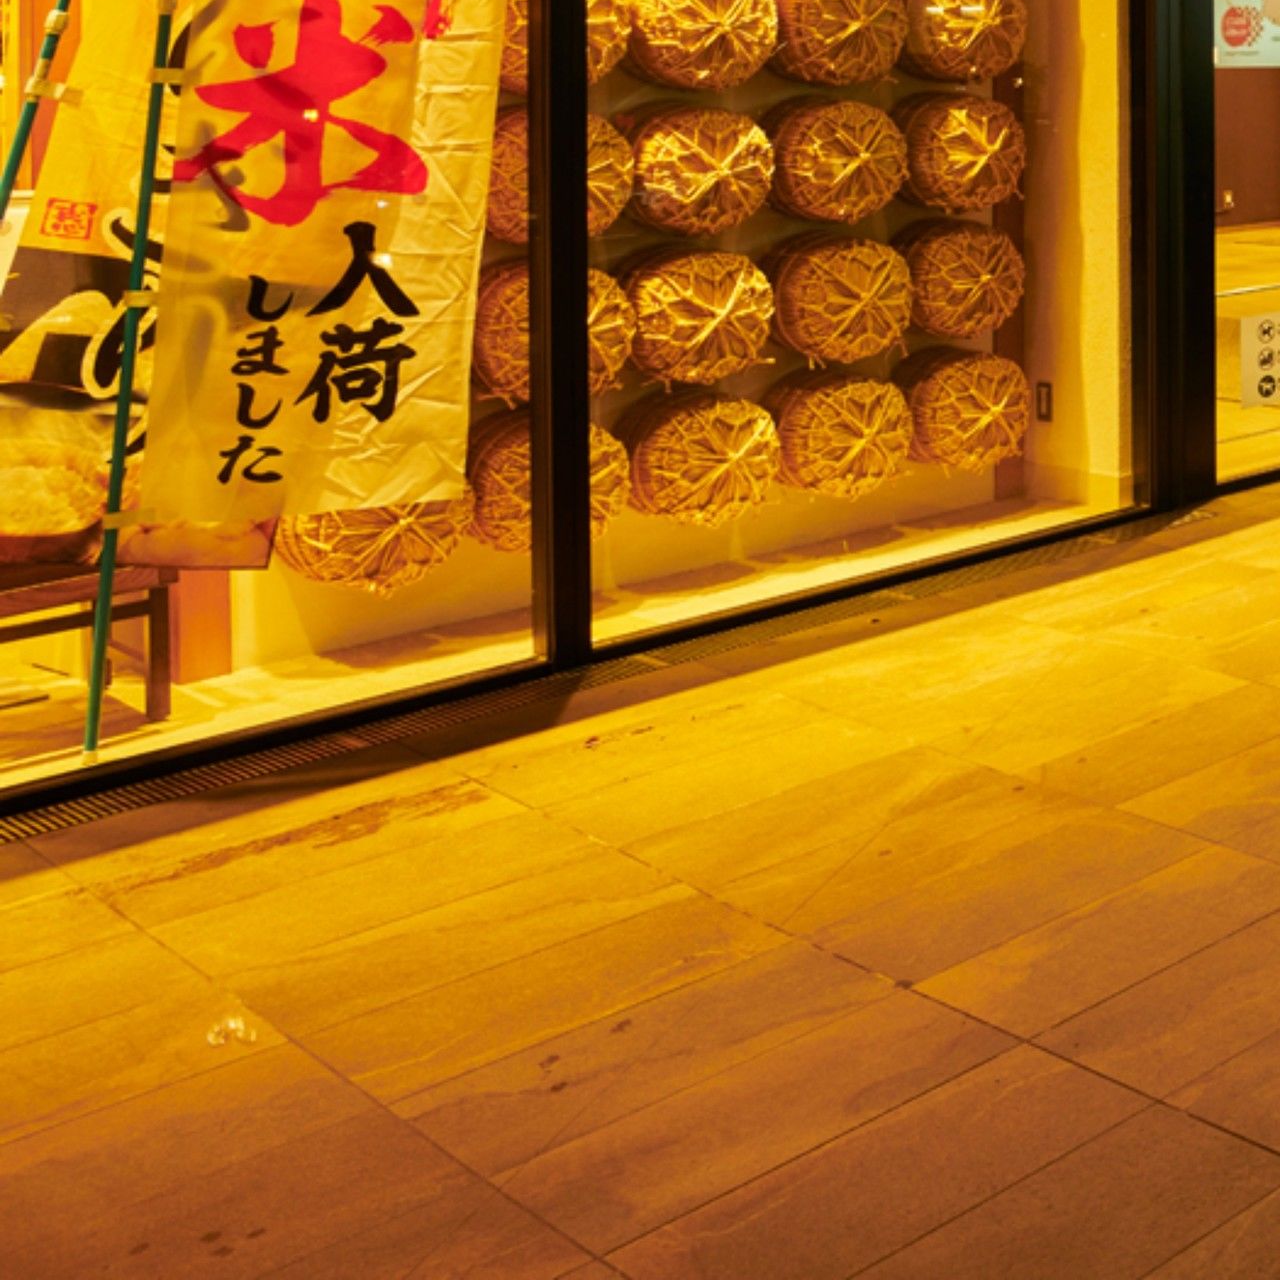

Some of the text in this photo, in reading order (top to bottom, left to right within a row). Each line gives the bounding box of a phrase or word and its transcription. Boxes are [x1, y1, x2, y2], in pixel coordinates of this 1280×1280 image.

[216, 275, 296, 484] しました
[294, 220, 420, 425] 入荷
